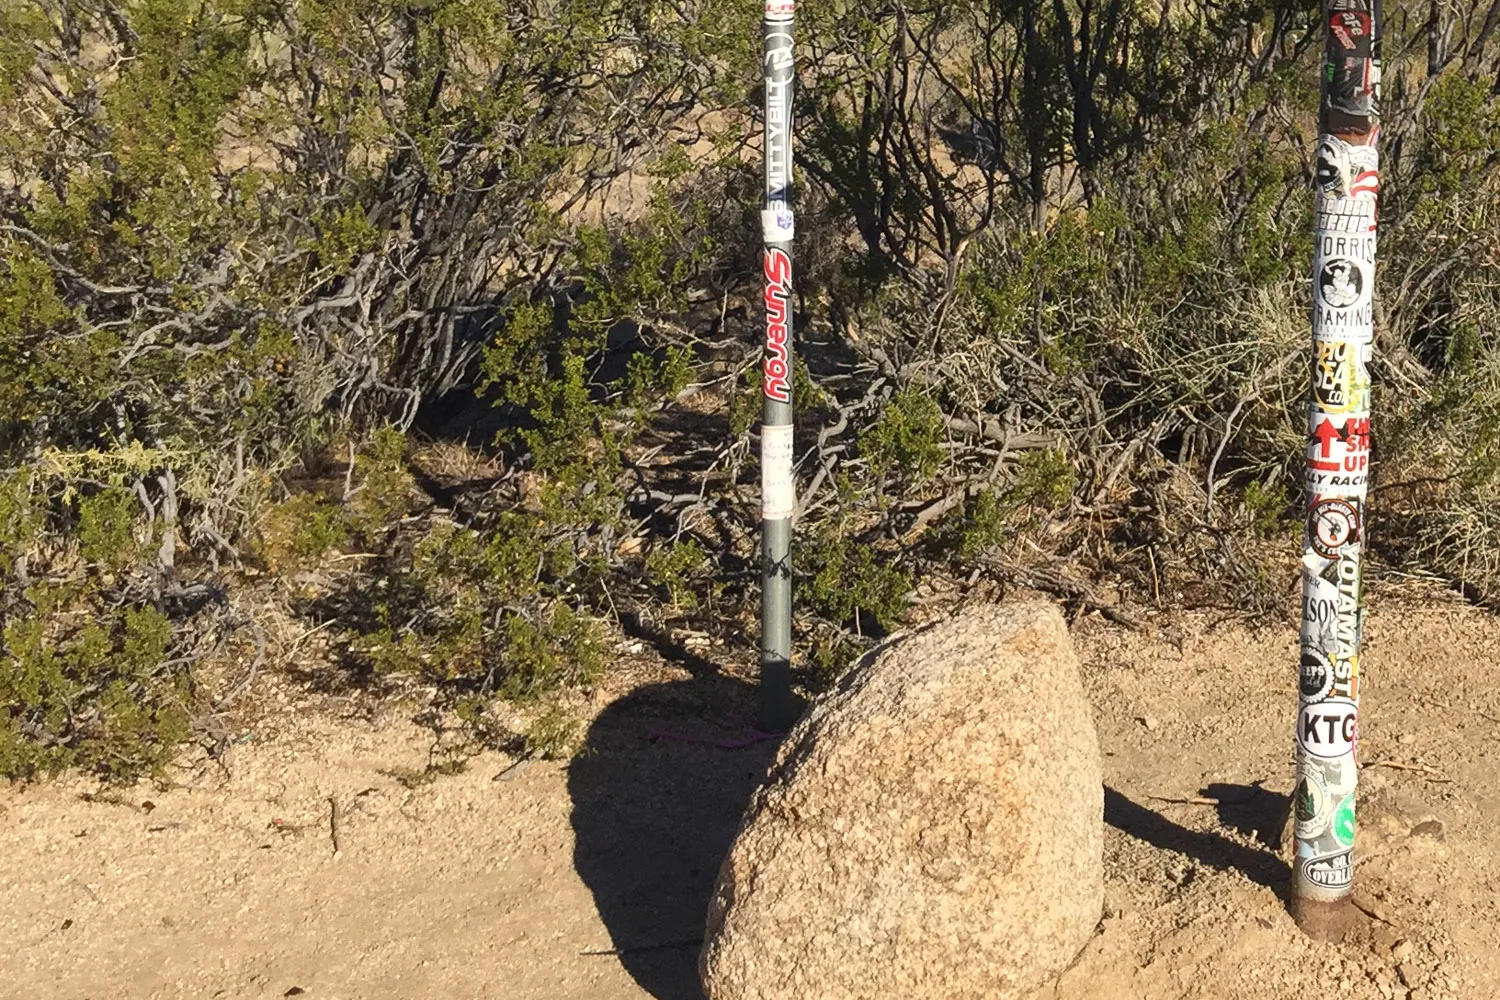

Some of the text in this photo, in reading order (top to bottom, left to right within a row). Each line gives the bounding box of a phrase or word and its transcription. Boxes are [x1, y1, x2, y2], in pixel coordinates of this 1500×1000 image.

[1315, 302, 1371, 327] RAMING
[1344, 455, 1367, 472] UP
[1301, 665, 1325, 677] EEPS
[1312, 867, 1353, 885] OVERL
